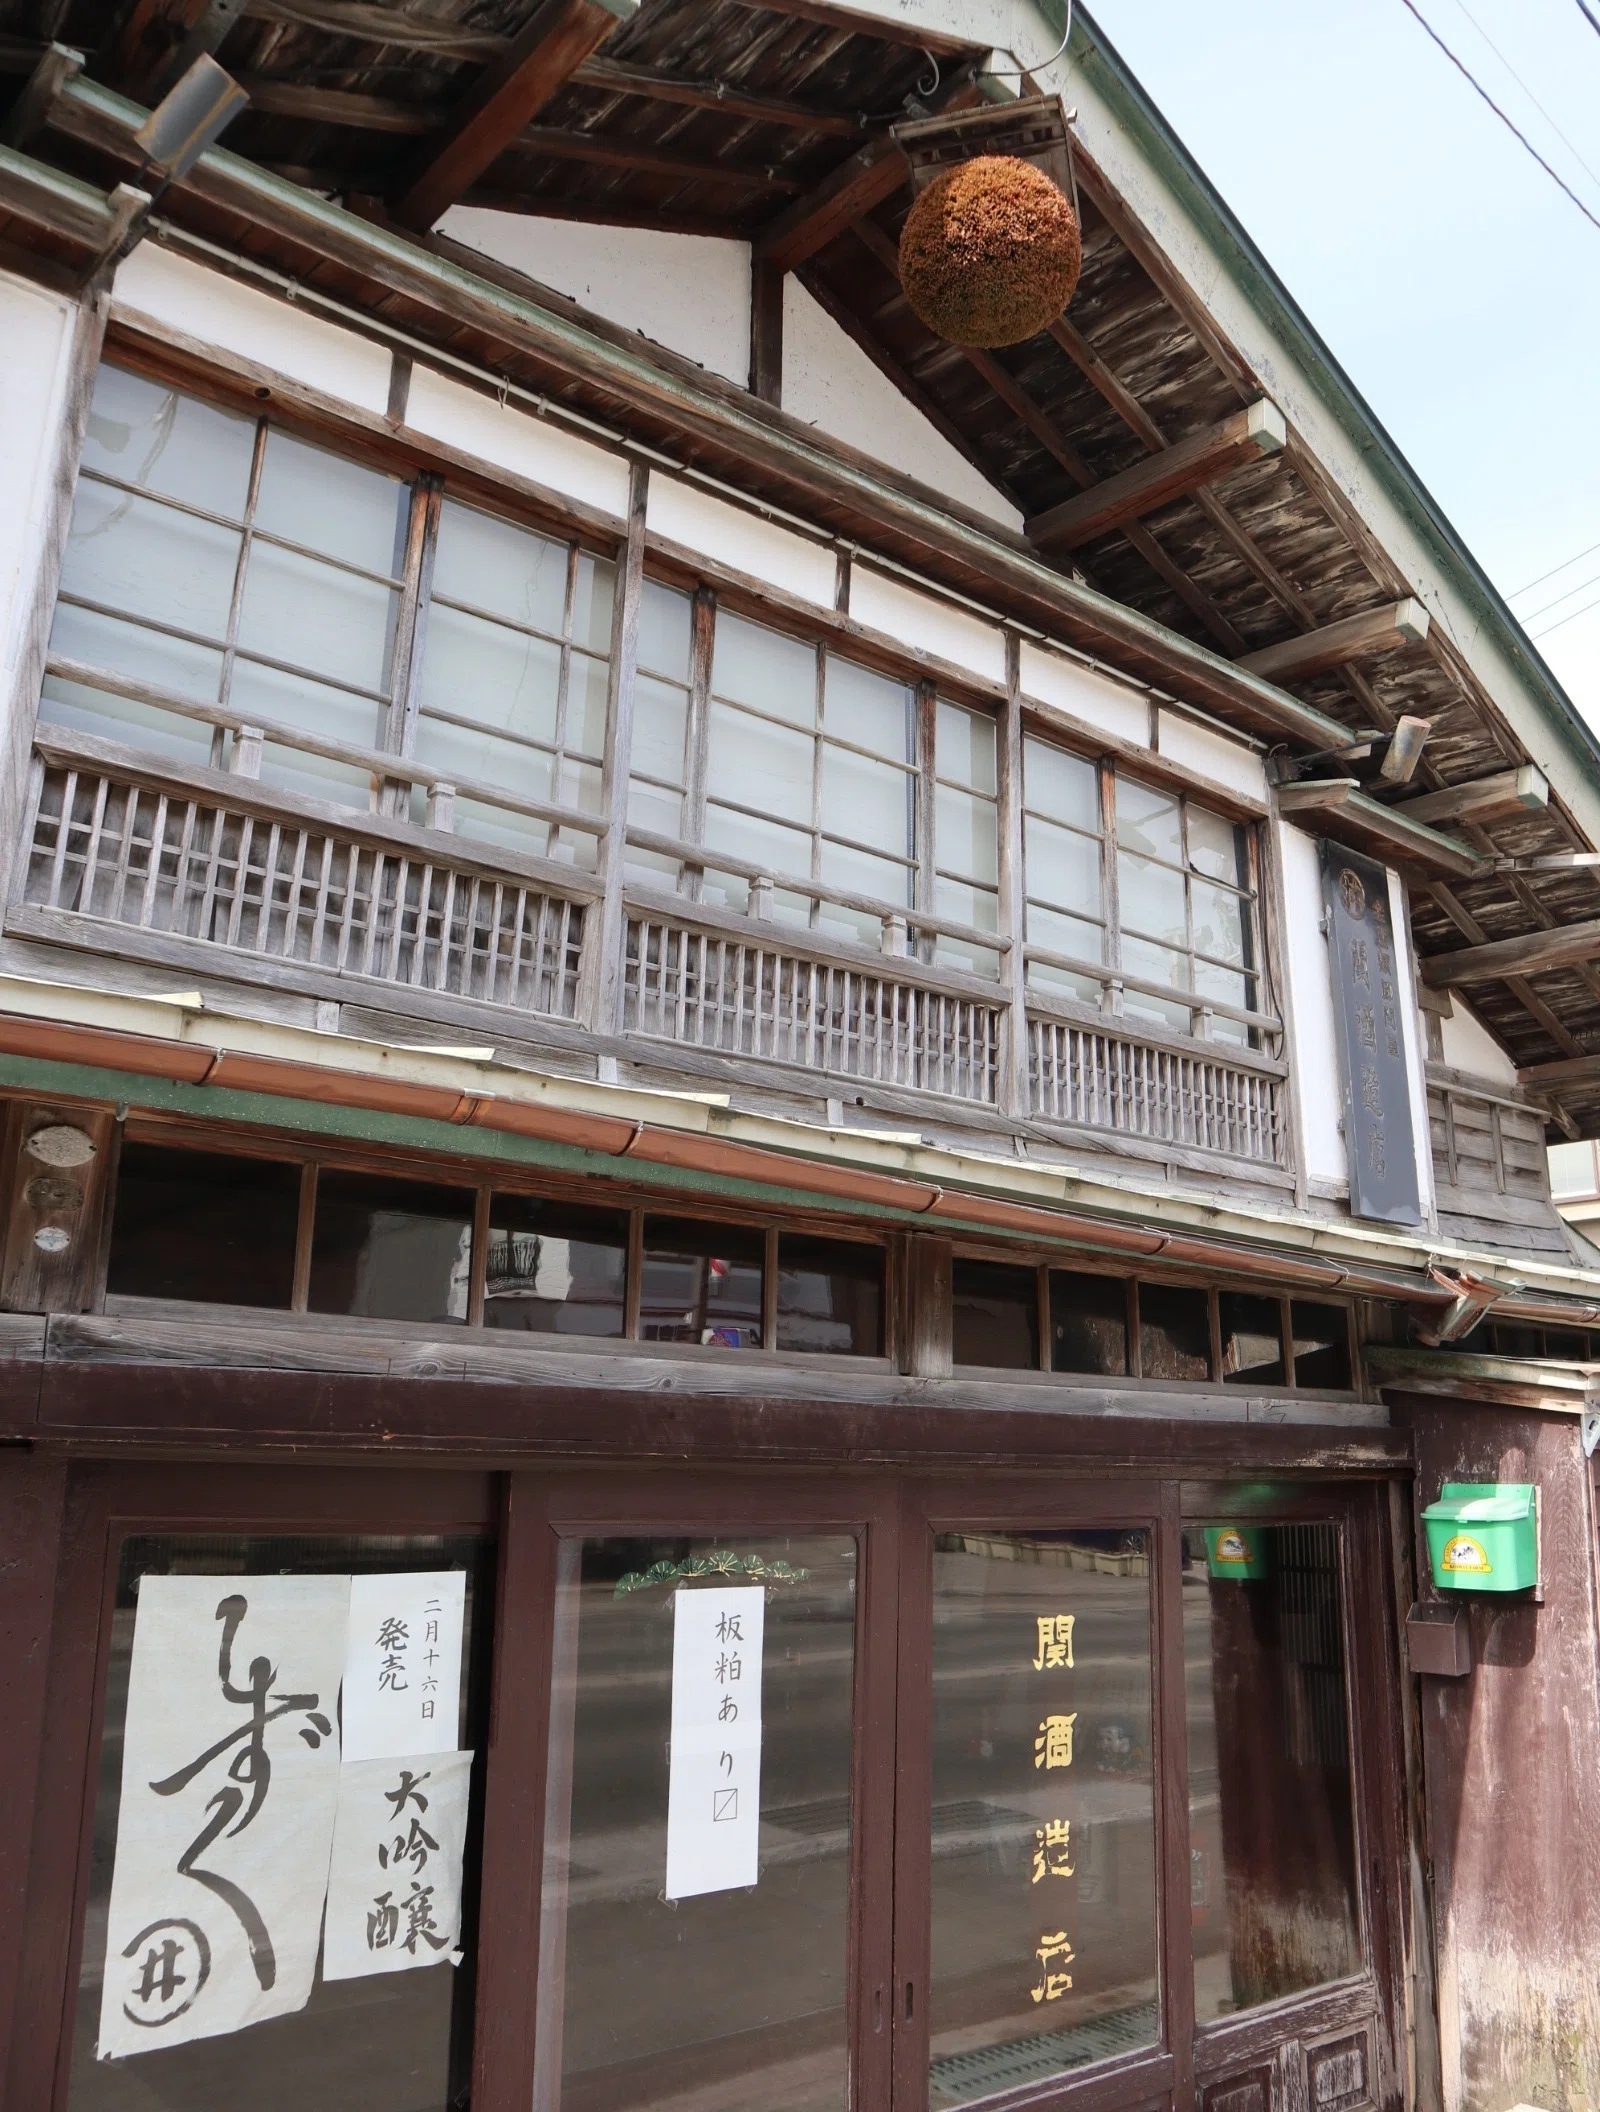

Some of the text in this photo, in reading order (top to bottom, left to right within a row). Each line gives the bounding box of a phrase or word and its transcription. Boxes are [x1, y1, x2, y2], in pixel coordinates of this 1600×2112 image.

[375, 1617, 409, 1691] 発売
[420, 1599, 442, 1721] 二月十六日
